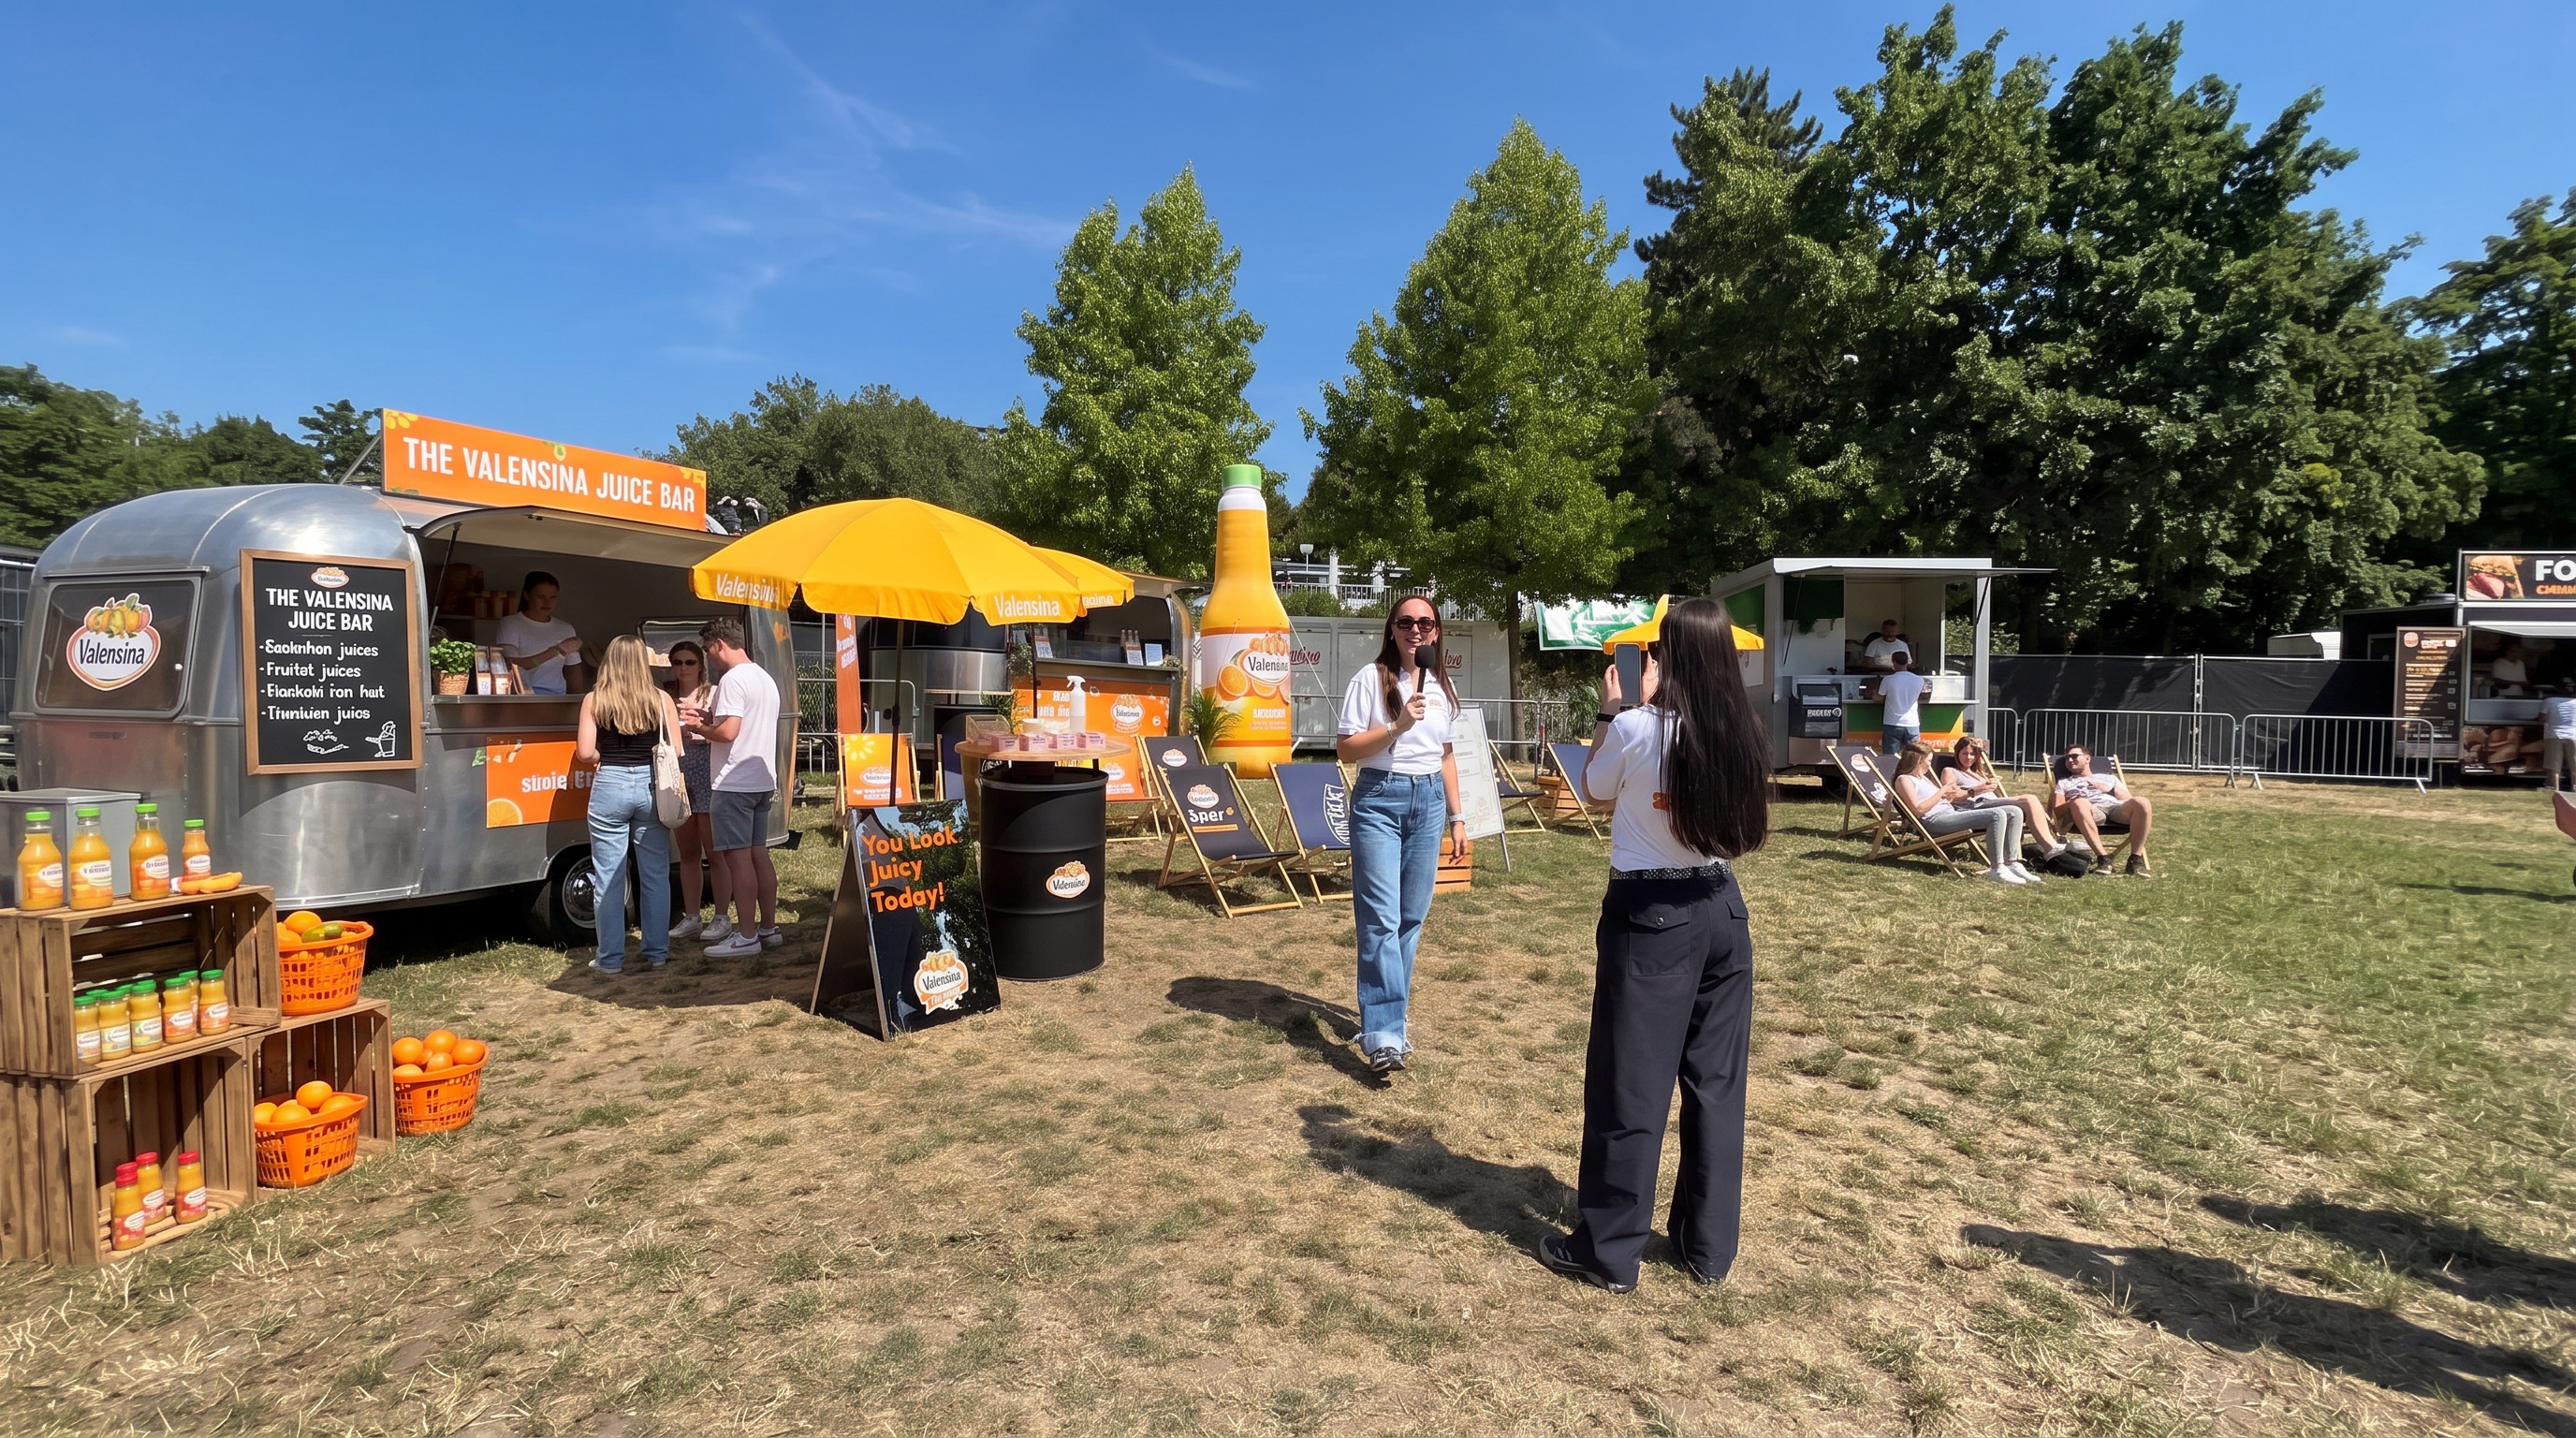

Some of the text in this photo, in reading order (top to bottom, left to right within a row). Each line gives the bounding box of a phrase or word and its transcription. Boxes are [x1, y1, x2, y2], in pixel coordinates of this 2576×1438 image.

[402, 436, 695, 513] THE VALENSINA JUICE BAR
[266, 588, 394, 611] THE VALENSINA
[994, 593, 1060, 618] Valensina
[288, 610, 373, 632] JUICE BAR
[80, 638, 145, 665] Valensina
[337, 642, 379, 661] juices
[318, 664, 361, 682] juices
[861, 826, 959, 857] You Look
[869, 857, 923, 888] Juicy
[871, 882, 944, 913] Today!
